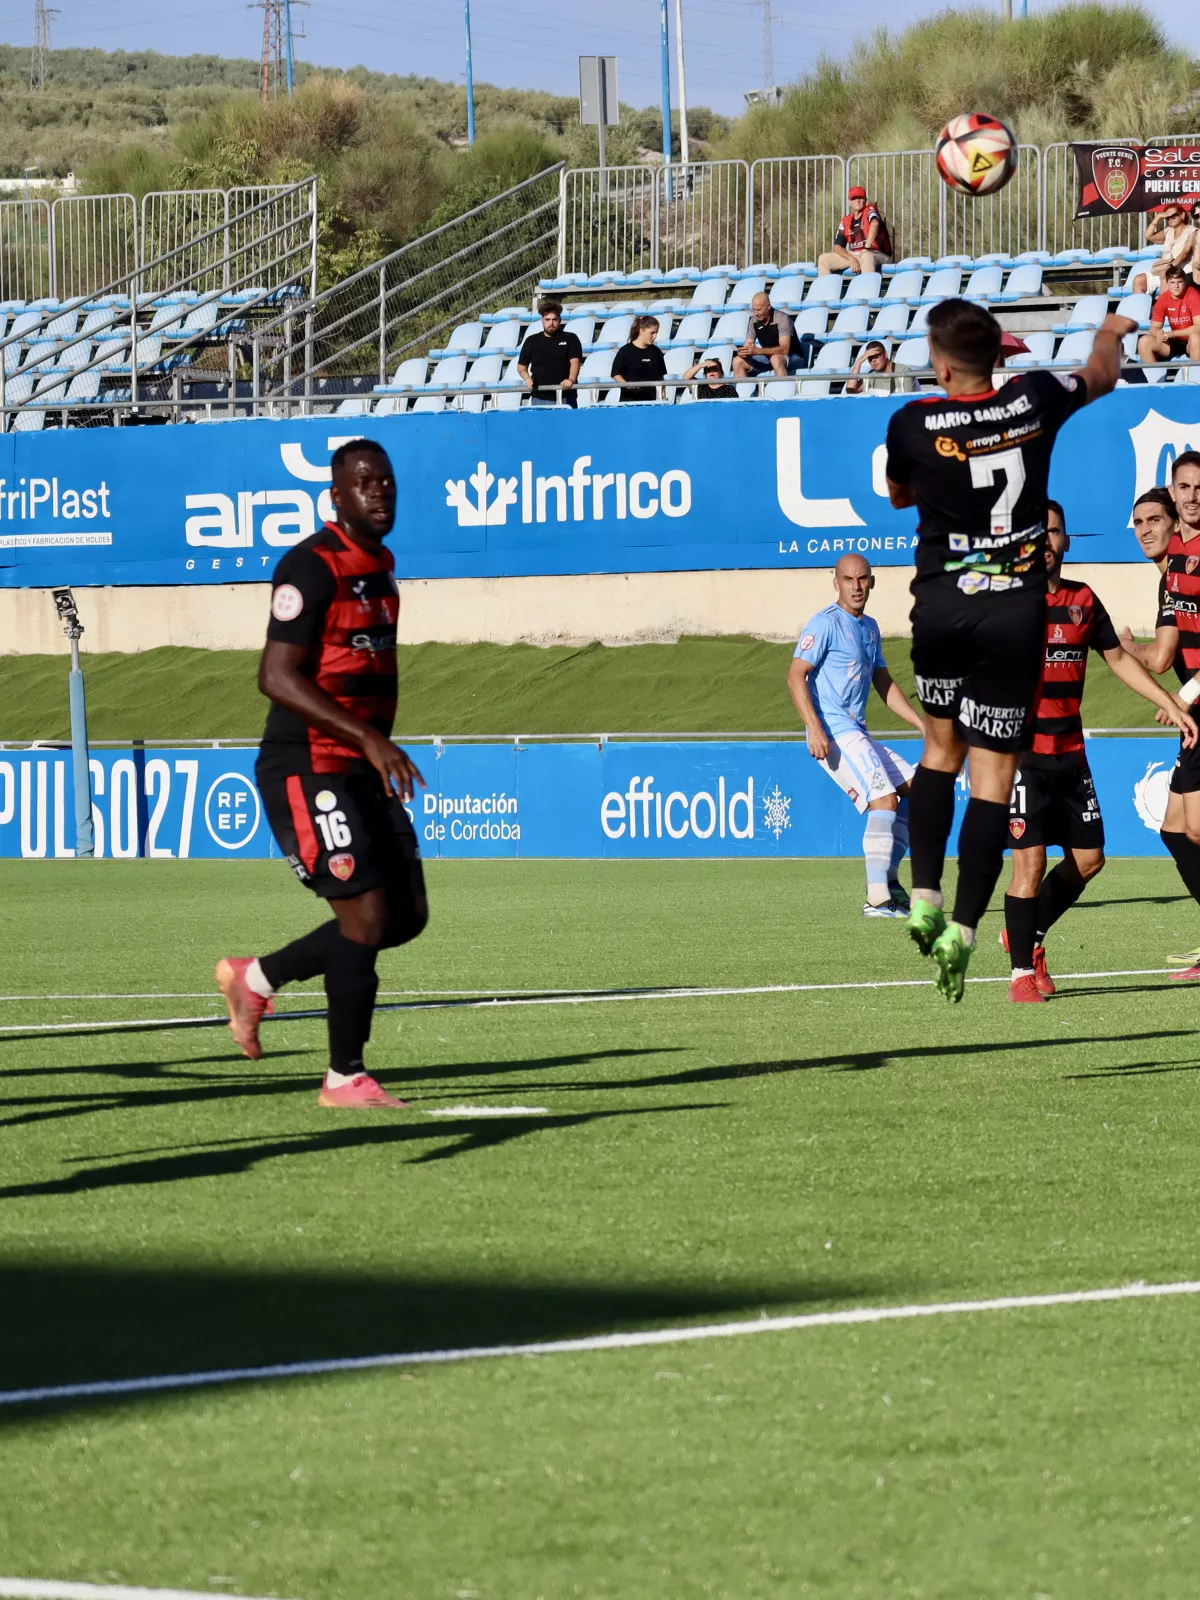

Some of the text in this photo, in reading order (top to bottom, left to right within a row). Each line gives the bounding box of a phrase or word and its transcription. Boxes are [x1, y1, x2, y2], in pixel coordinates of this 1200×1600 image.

[1108, 159, 1123, 168] F.C.
[1145, 180, 1180, 193] PUENTE
[925, 412, 971, 430] MARIO
[965, 434, 1001, 449] arroyo
[521, 455, 691, 524] Infrico
[969, 447, 1026, 535] 7
[778, 540, 799, 553] LA
[979, 704, 1026, 718] PUERTAS
[218, 792, 247, 807] RF
[424, 793, 517, 815] Diputación
[601, 776, 753, 839] efficold
[218, 814, 247, 830] EF
[315, 810, 352, 851] 16
[424, 819, 521, 840] de Córdoba
